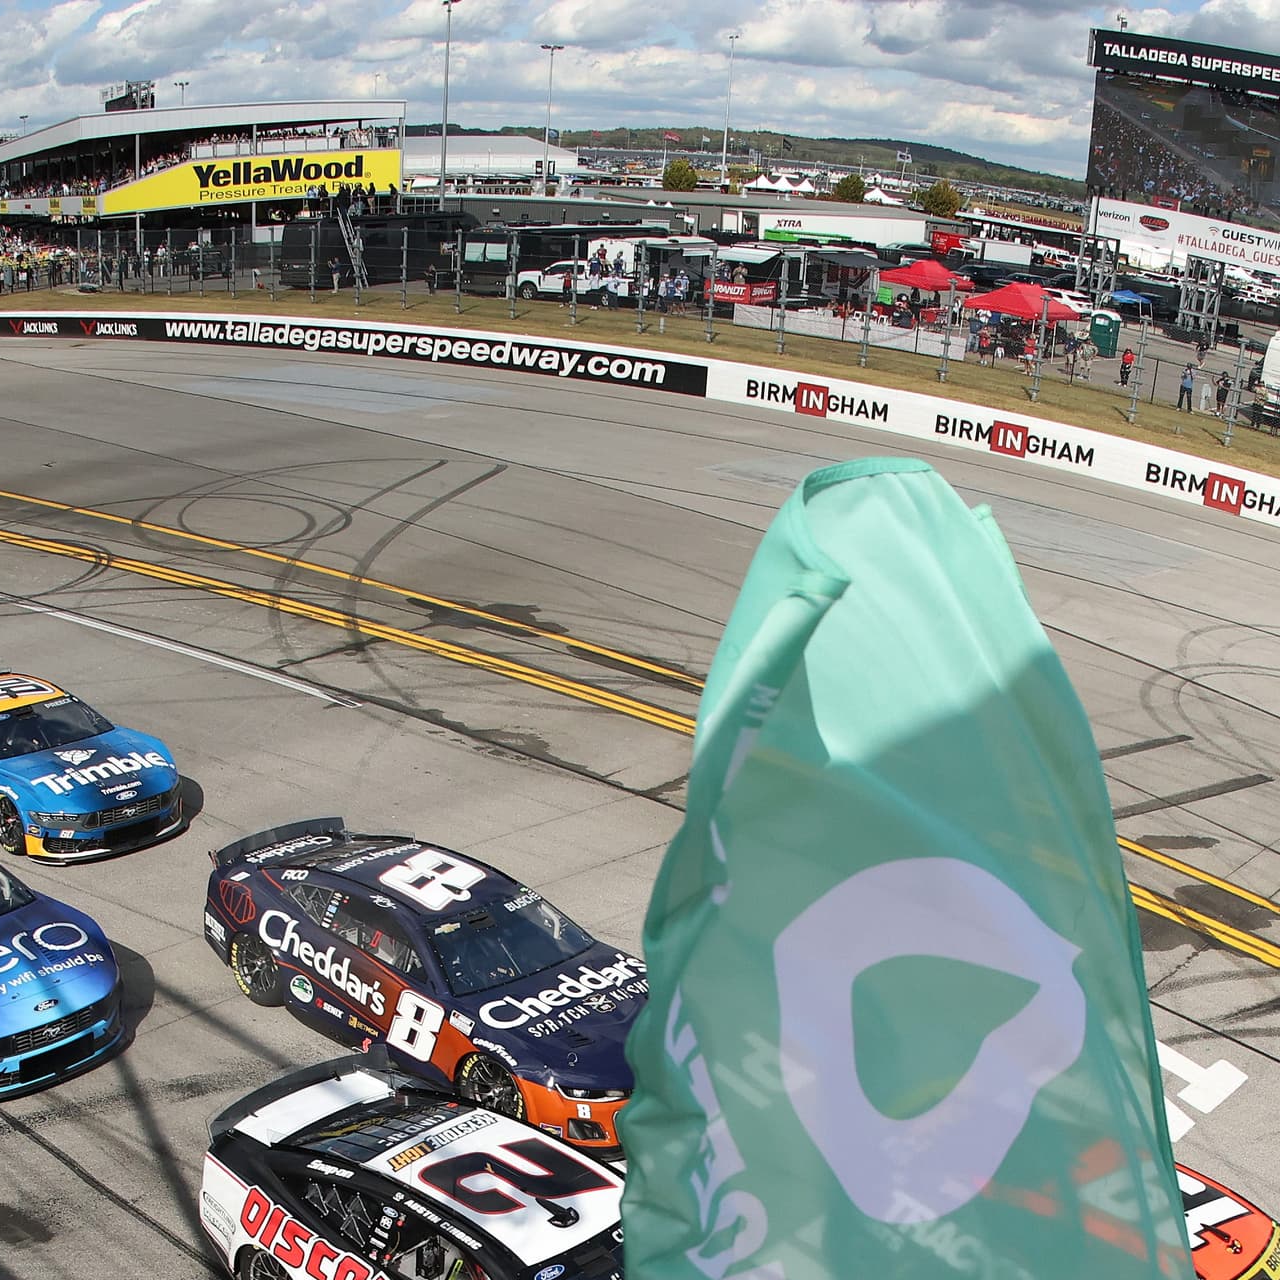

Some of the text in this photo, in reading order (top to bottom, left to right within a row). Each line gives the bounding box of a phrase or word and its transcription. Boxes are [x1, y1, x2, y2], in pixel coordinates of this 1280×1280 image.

[1103, 43, 1188, 67] TALLADEGA
[193, 155, 363, 188] YellaWood
[200, 187, 266, 201] Pressure
[776, 219, 802, 229] XTRA
[1098, 209, 1131, 223] verizon
[166, 320, 666, 386] www.talladegasuperspeedway.com
[745, 379, 889, 423] BIRMINGHAM
[934, 413, 1095, 468] BIRMINGHAM
[59, 829, 76, 840] 60
[280, 869, 310, 881] FICO
[377, 847, 488, 912] 8
[8, 969, 36, 992] wifi
[36, 954, 85, 982] should
[85, 951, 105, 967] be
[258, 909, 387, 1017] Cheddar's
[478, 952, 649, 1030] Cheddar's
[322, 1002, 345, 1020] SENIX
[384, 988, 446, 1063] 8
[461, 1053, 480, 1078] EAGLE
[471, 1036, 519, 1068] GOODYEAR
[575, 1103, 592, 1120] 8
[387, 1112, 501, 1172] KEYSTONE LIGHT
[306, 1159, 355, 1180] Snap-on
[417, 1137, 624, 1216] 2
[404, 1199, 484, 1251] AUSTIN CINDRIC
